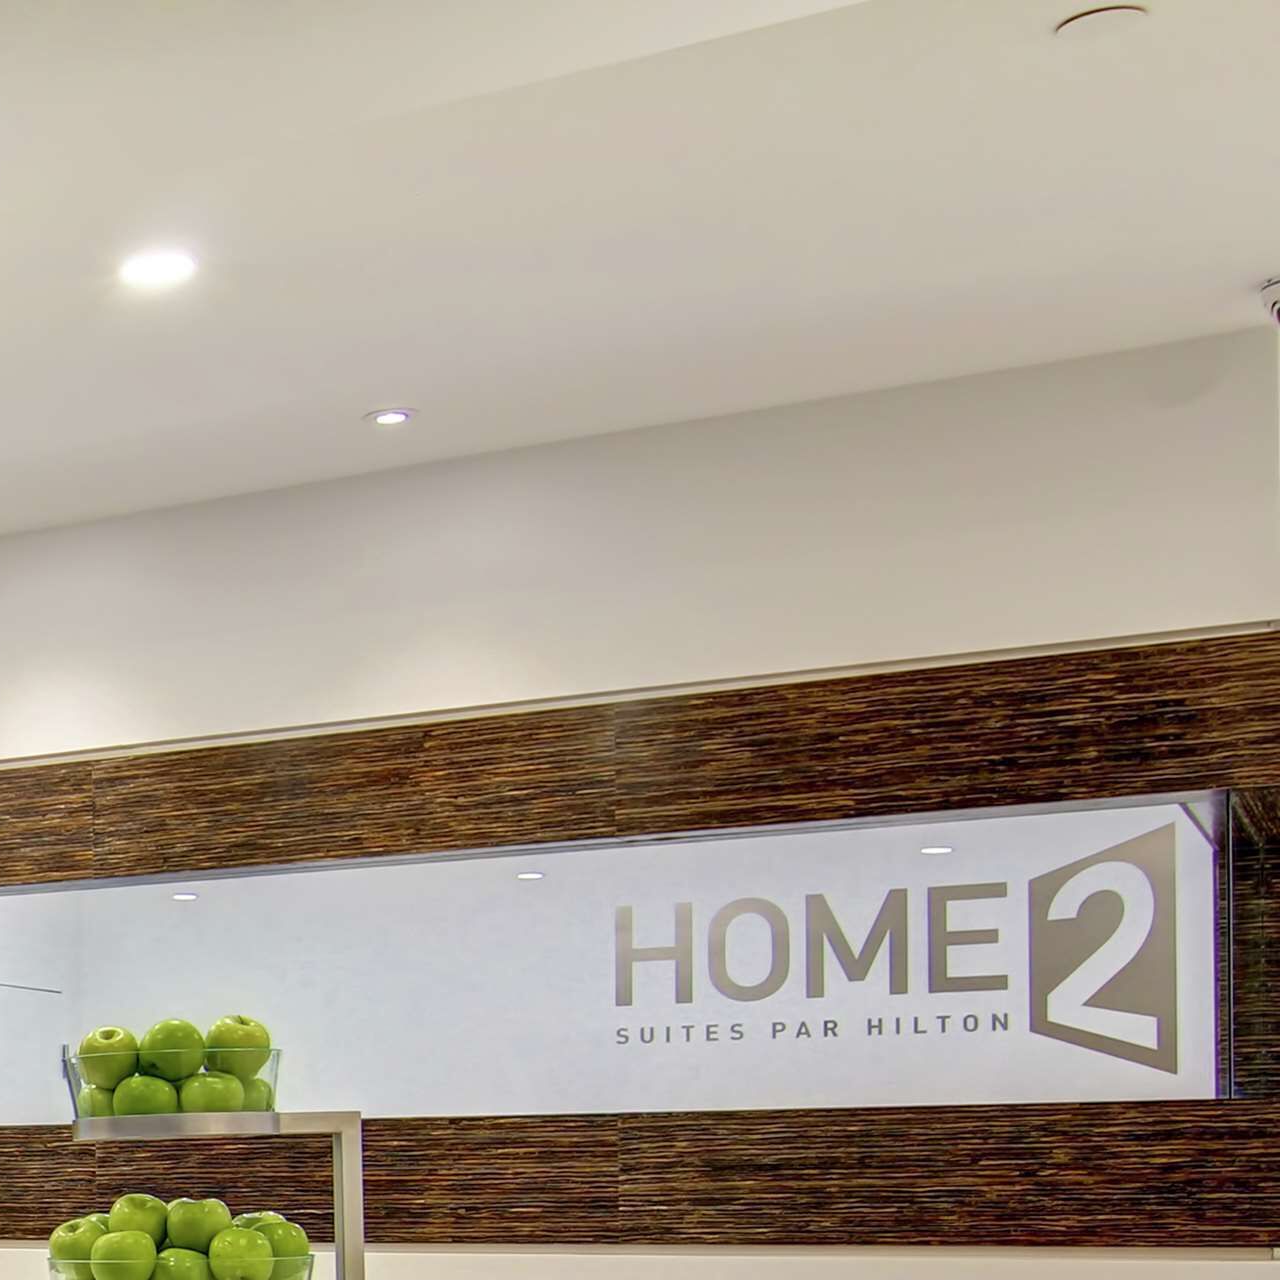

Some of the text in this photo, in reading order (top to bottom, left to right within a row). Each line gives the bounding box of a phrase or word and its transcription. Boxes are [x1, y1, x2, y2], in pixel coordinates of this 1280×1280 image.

[615, 1012, 1010, 1045] SUITES PAR HILTON
